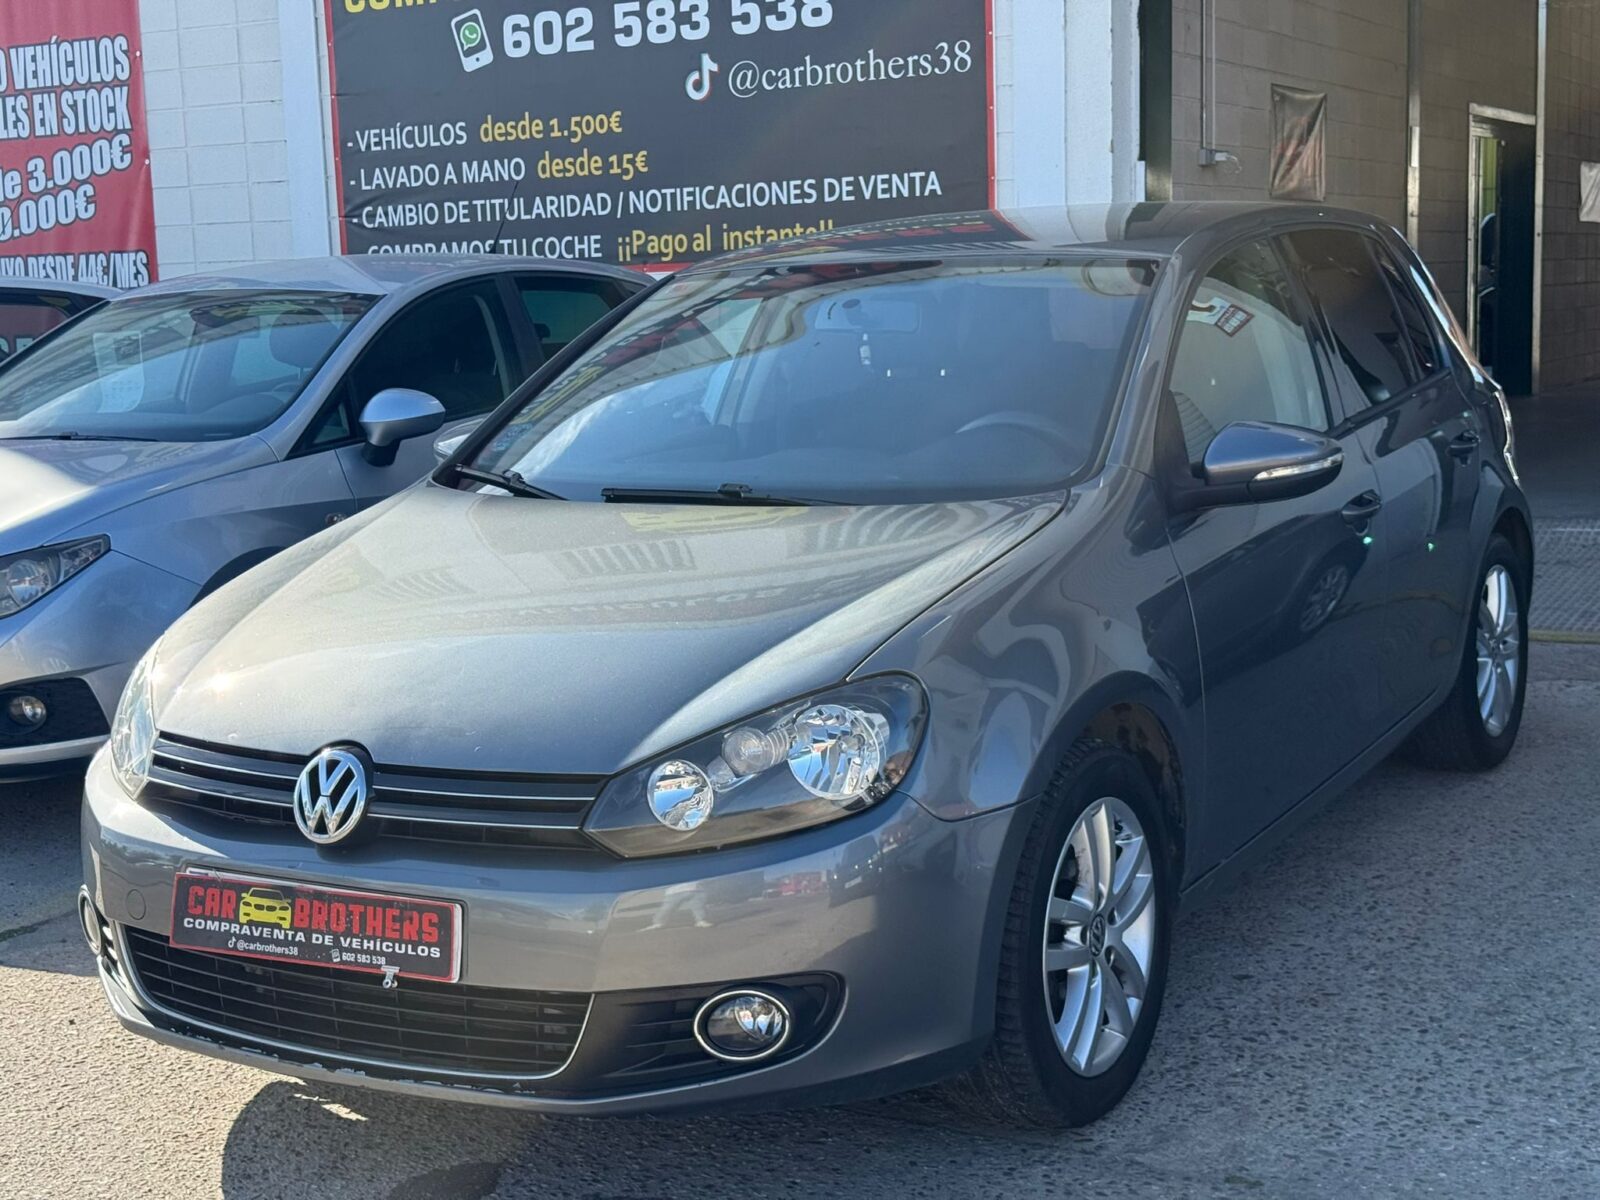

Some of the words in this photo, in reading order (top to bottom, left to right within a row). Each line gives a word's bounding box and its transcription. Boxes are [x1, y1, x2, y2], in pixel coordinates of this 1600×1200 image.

[503, 7, 595, 58] 602
[613, 0, 710, 47] 583
[730, 0, 833, 36] 538
[9, 35, 131, 90] VEHÍCULOS
[728, 39, 972, 98] @carbrothers38
[32, 92, 59, 137] EN
[60, 86, 132, 136] STOCK
[355, 121, 468, 152] VEHÍCULOS
[479, 111, 544, 143] desde
[549, 110, 623, 144] 1.500€
[0, 168, 22, 202] e
[26, 133, 133, 194] 3.000€
[360, 163, 440, 191] LAVADO
[443, 161, 458, 186] A
[461, 157, 526, 184] MANO
[537, 147, 603, 179] desde
[608, 150, 649, 181] 15€
[361, 202, 440, 229] CAMBIO
[443, 200, 471, 225] DE
[471, 192, 612, 223] TITULARIDAD
[628, 179, 818, 215] NOTIFICACIONES
[823, 176, 856, 203] DE
[858, 170, 943, 200] VENTA
[498, 239, 527, 257] TU
[531, 234, 603, 260] COCHE
[692, 223, 712, 252] al
[27, 253, 75, 281] DESDE
[186, 885, 237, 920] CAR
[293, 897, 440, 943] BROTHERS
[183, 917, 306, 943] COMPRAVENTA
[311, 932, 334, 946] DE
[339, 935, 441, 959] VEHÍCULOS
[236, 939, 299, 956] @carbrothers38
[341, 951, 356, 962] 602
[356, 952, 371, 964] 583
